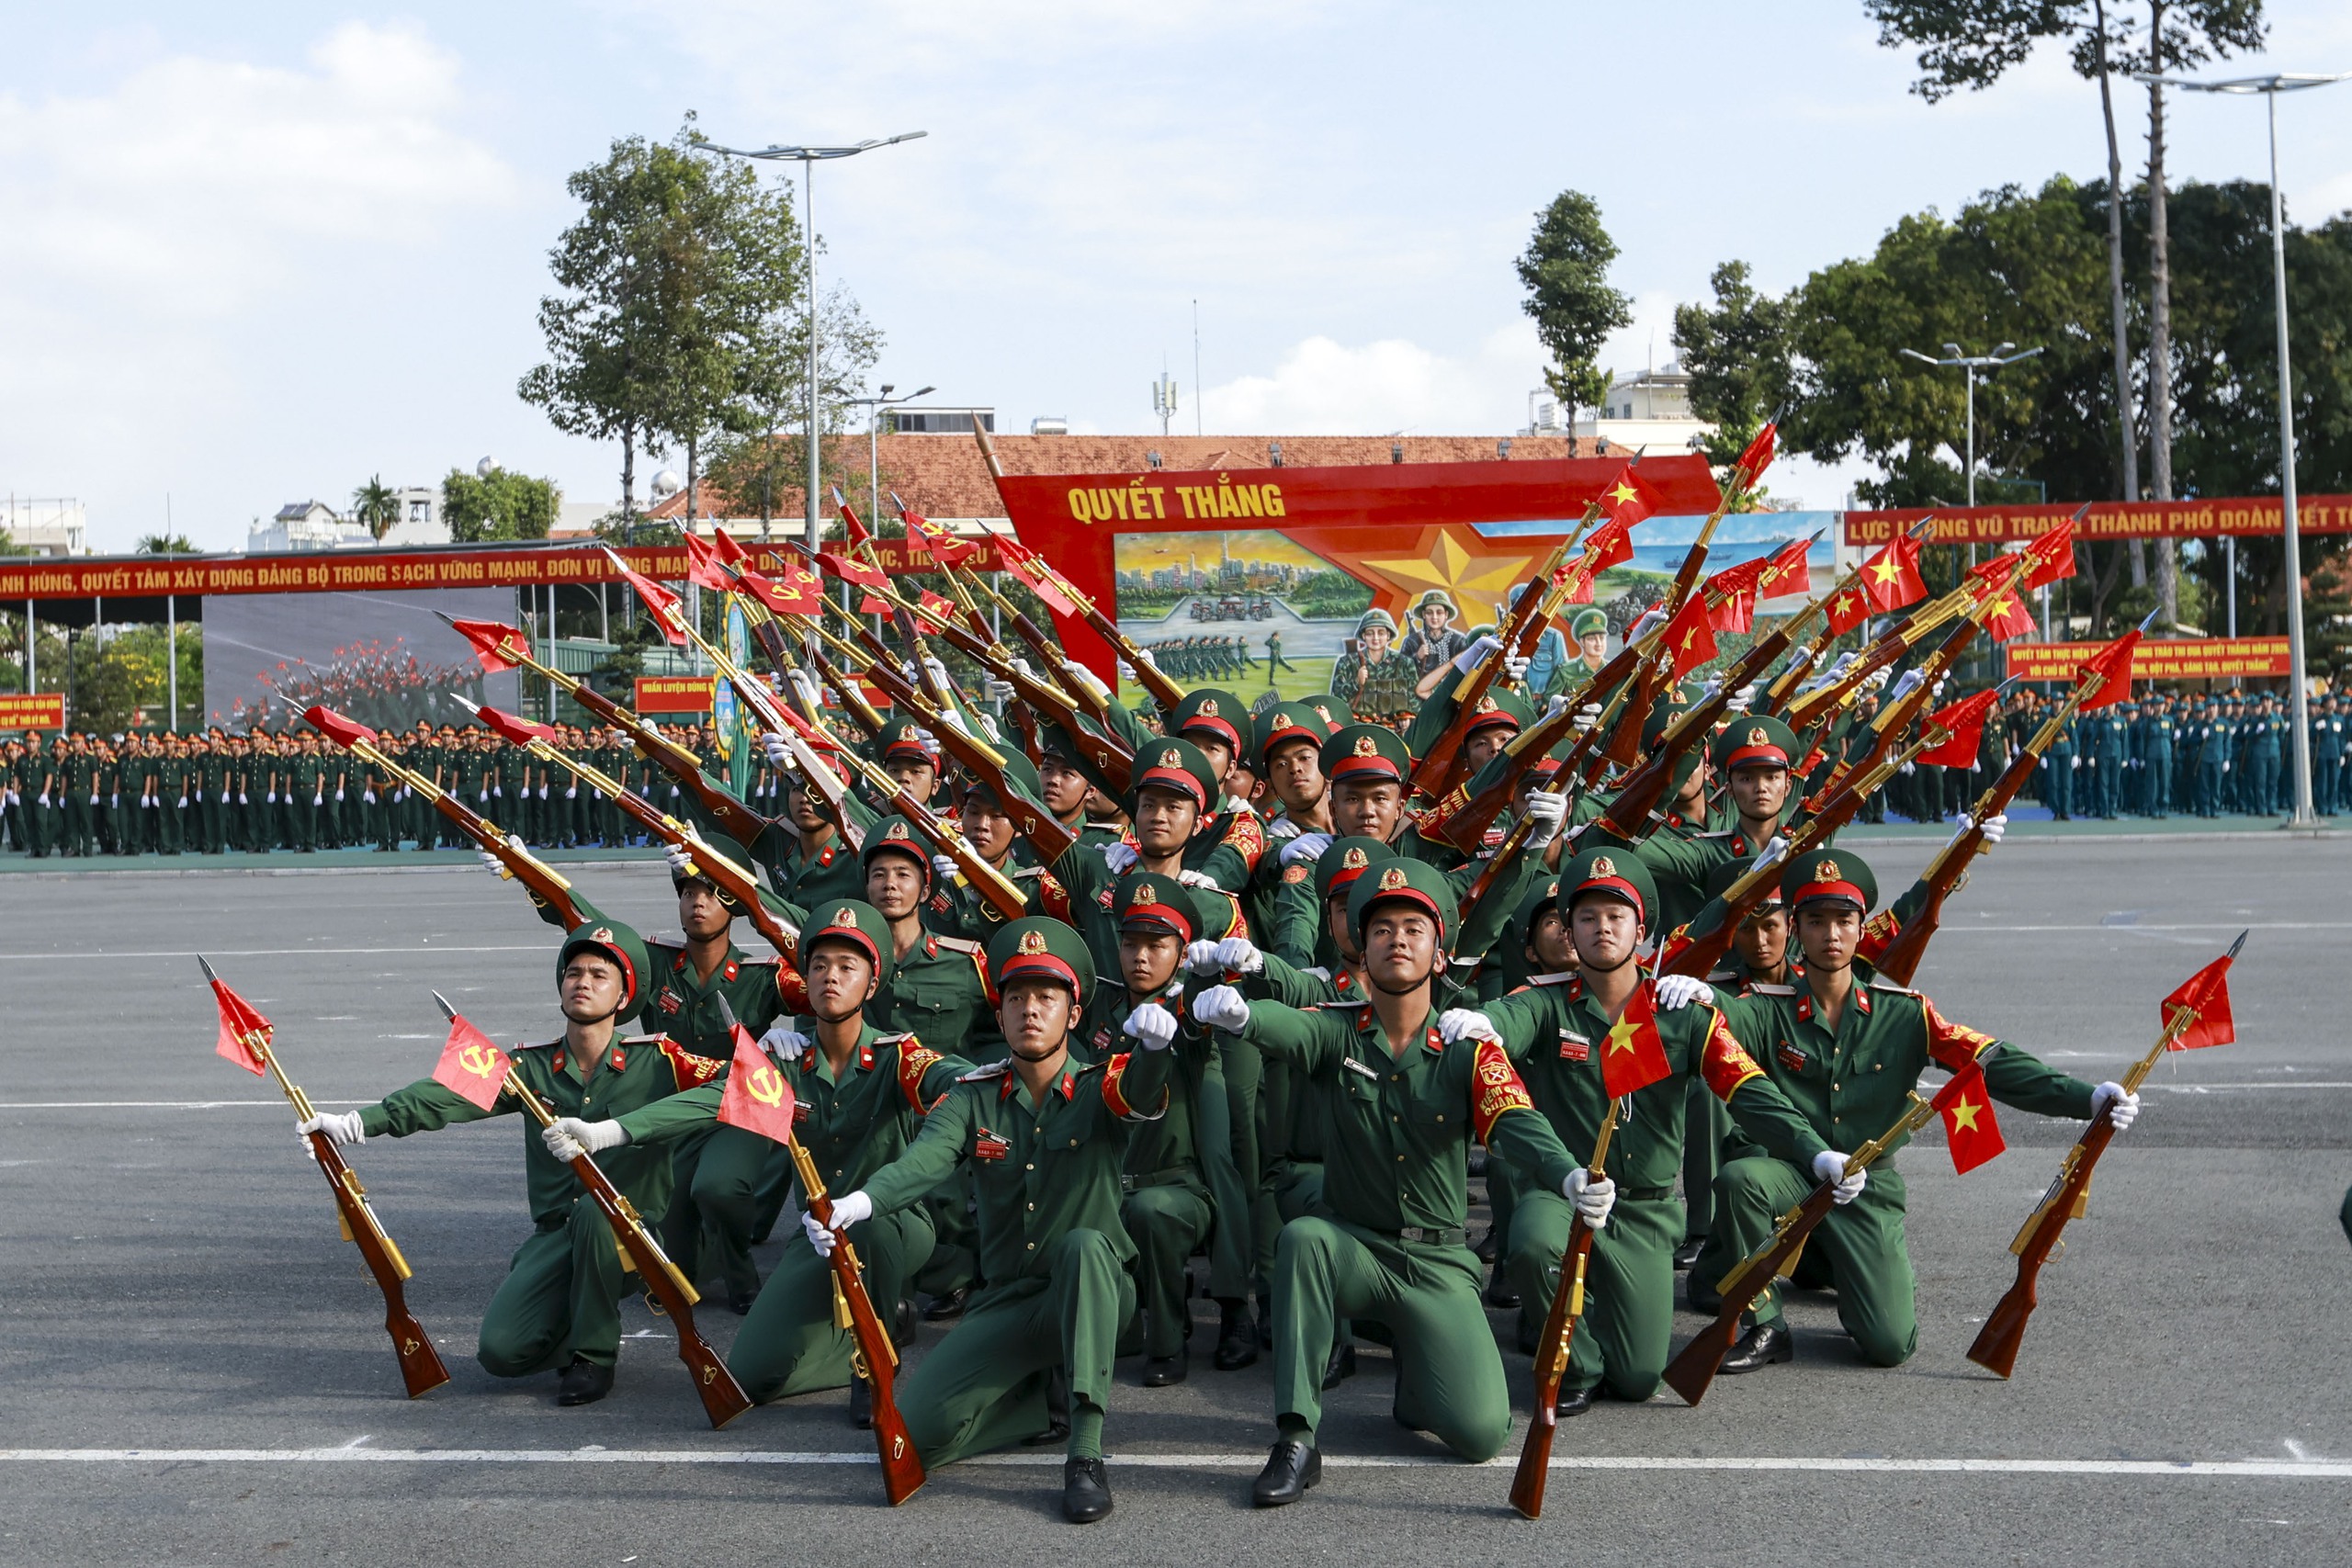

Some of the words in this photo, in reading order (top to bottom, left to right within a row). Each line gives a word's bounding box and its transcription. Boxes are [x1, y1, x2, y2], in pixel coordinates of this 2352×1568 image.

[1068, 473, 1165, 525] QUYẾT
[1175, 470, 1285, 519] THẮNG
[1849, 520, 1890, 546] LỰC
[1975, 514, 2003, 536] VŨ
[2088, 511, 2162, 534] THÀNH
[2168, 505, 2213, 531] PHỐ
[2220, 506, 2281, 529] ĐOÀN
[29, 572, 77, 592] HÙNG,
[82, 568, 130, 592] QUYẾT
[135, 569, 169, 588] TÂM
[175, 568, 205, 588] XÂY
[209, 569, 254, 590] DỰNG
[258, 563, 302, 585] ĐẢNG
[307, 563, 329, 587] BỘ
[334, 565, 386, 583] TRONG
[391, 564, 435, 584] SẠCH
[439, 560, 483, 581] VỮNG
[489, 560, 542, 581] MẠNH,
[547, 558, 582, 576] ĐƠN
[586, 558, 602, 579] VỊ
[2012, 646, 2034, 662] QUYẾT
[2036, 647, 2052, 661] TÂM
[2202, 643, 2226, 659] QUYẾT
[2227, 642, 2252, 657] THẮNG
[2222, 660, 2245, 674] QUYẾT
[642, 681, 662, 694] HUẤN
[662, 681, 687, 695] LUYỆN
